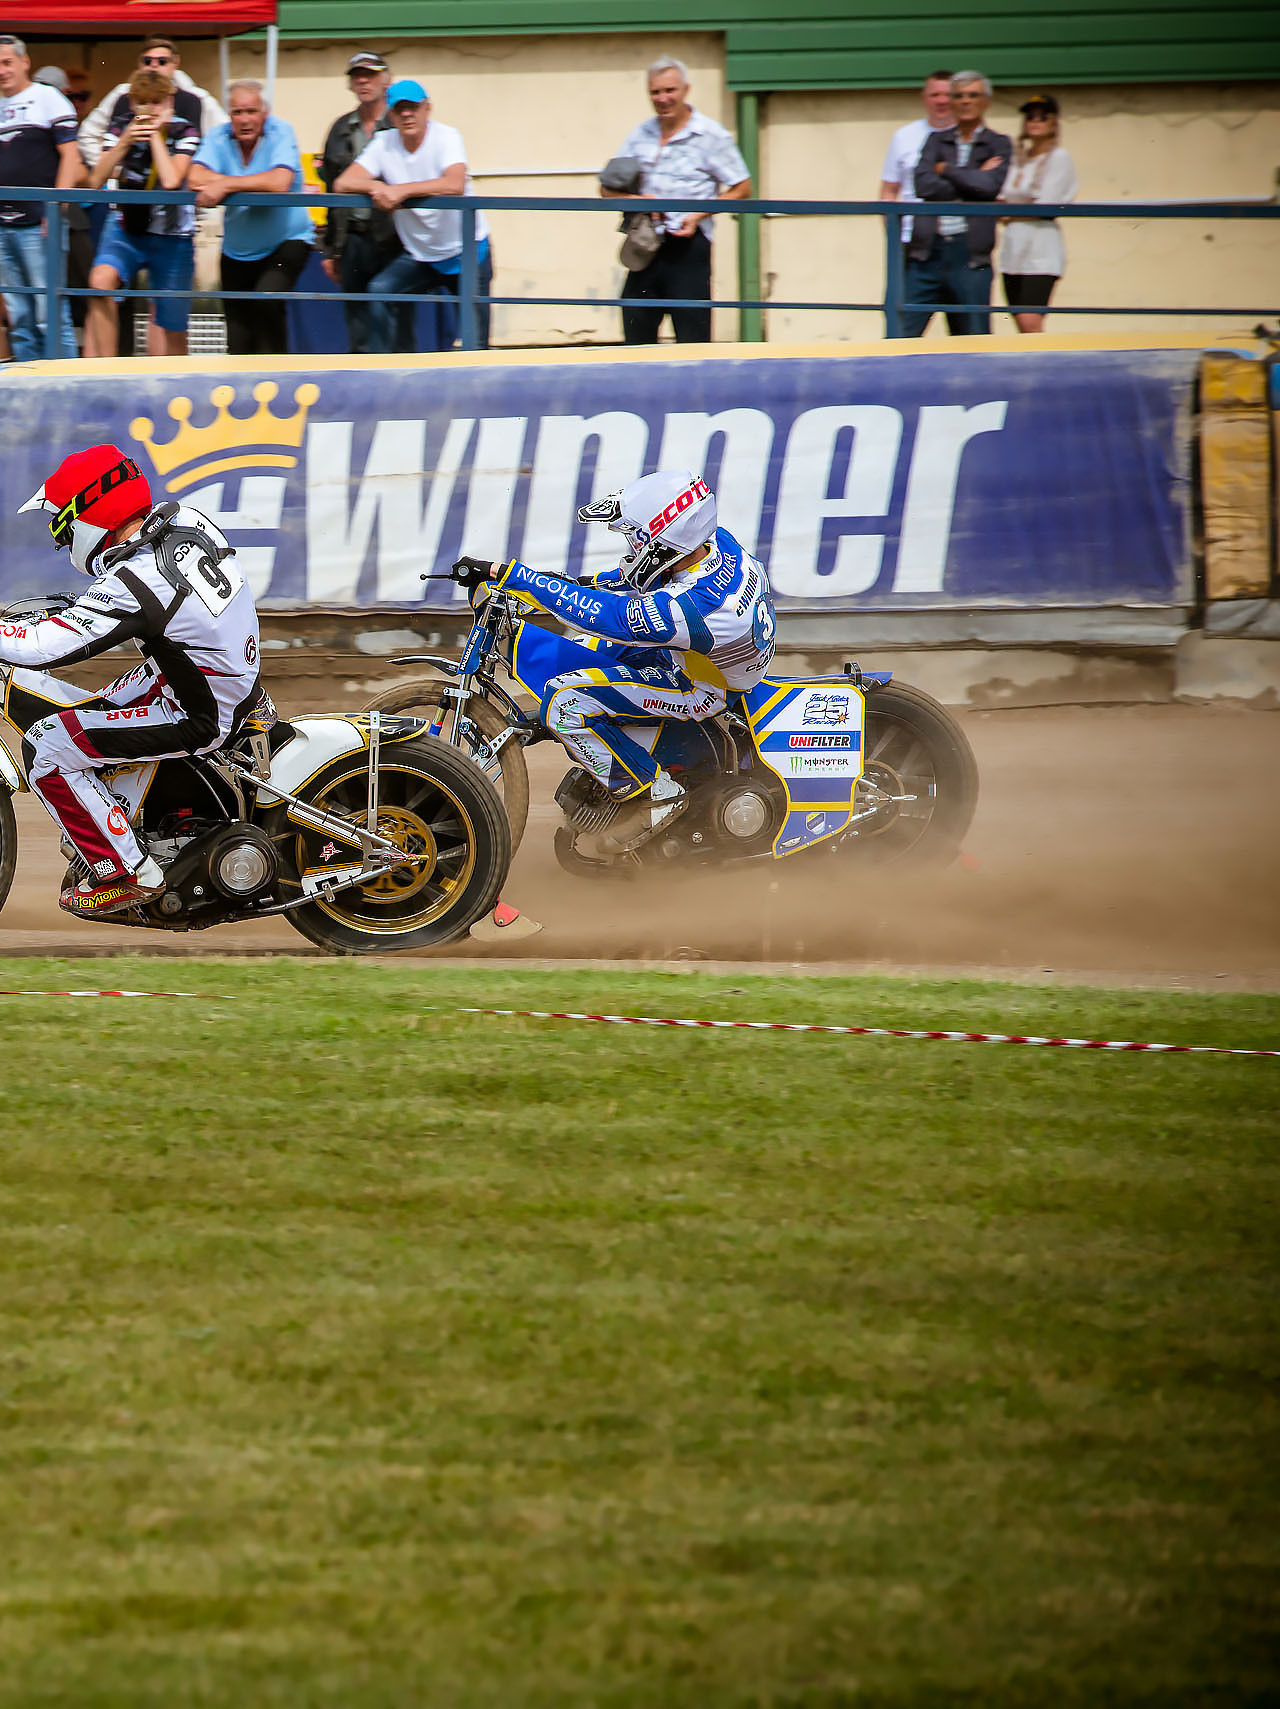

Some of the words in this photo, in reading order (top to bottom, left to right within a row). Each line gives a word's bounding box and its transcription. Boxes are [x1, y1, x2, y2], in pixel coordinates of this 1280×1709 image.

[648, 480, 709, 538] SCOTT
[197, 555, 233, 600] 9
[516, 566, 602, 615] NICOLAUS
[555, 599, 596, 624] BANK
[757, 600, 774, 641] 3
[105, 707, 149, 721] BAR
[642, 698, 689, 715] UNIFILTE
[803, 699, 850, 720] 25
[790, 736, 850, 747] UNIFILTER
[804, 757, 849, 766] MONSTER
